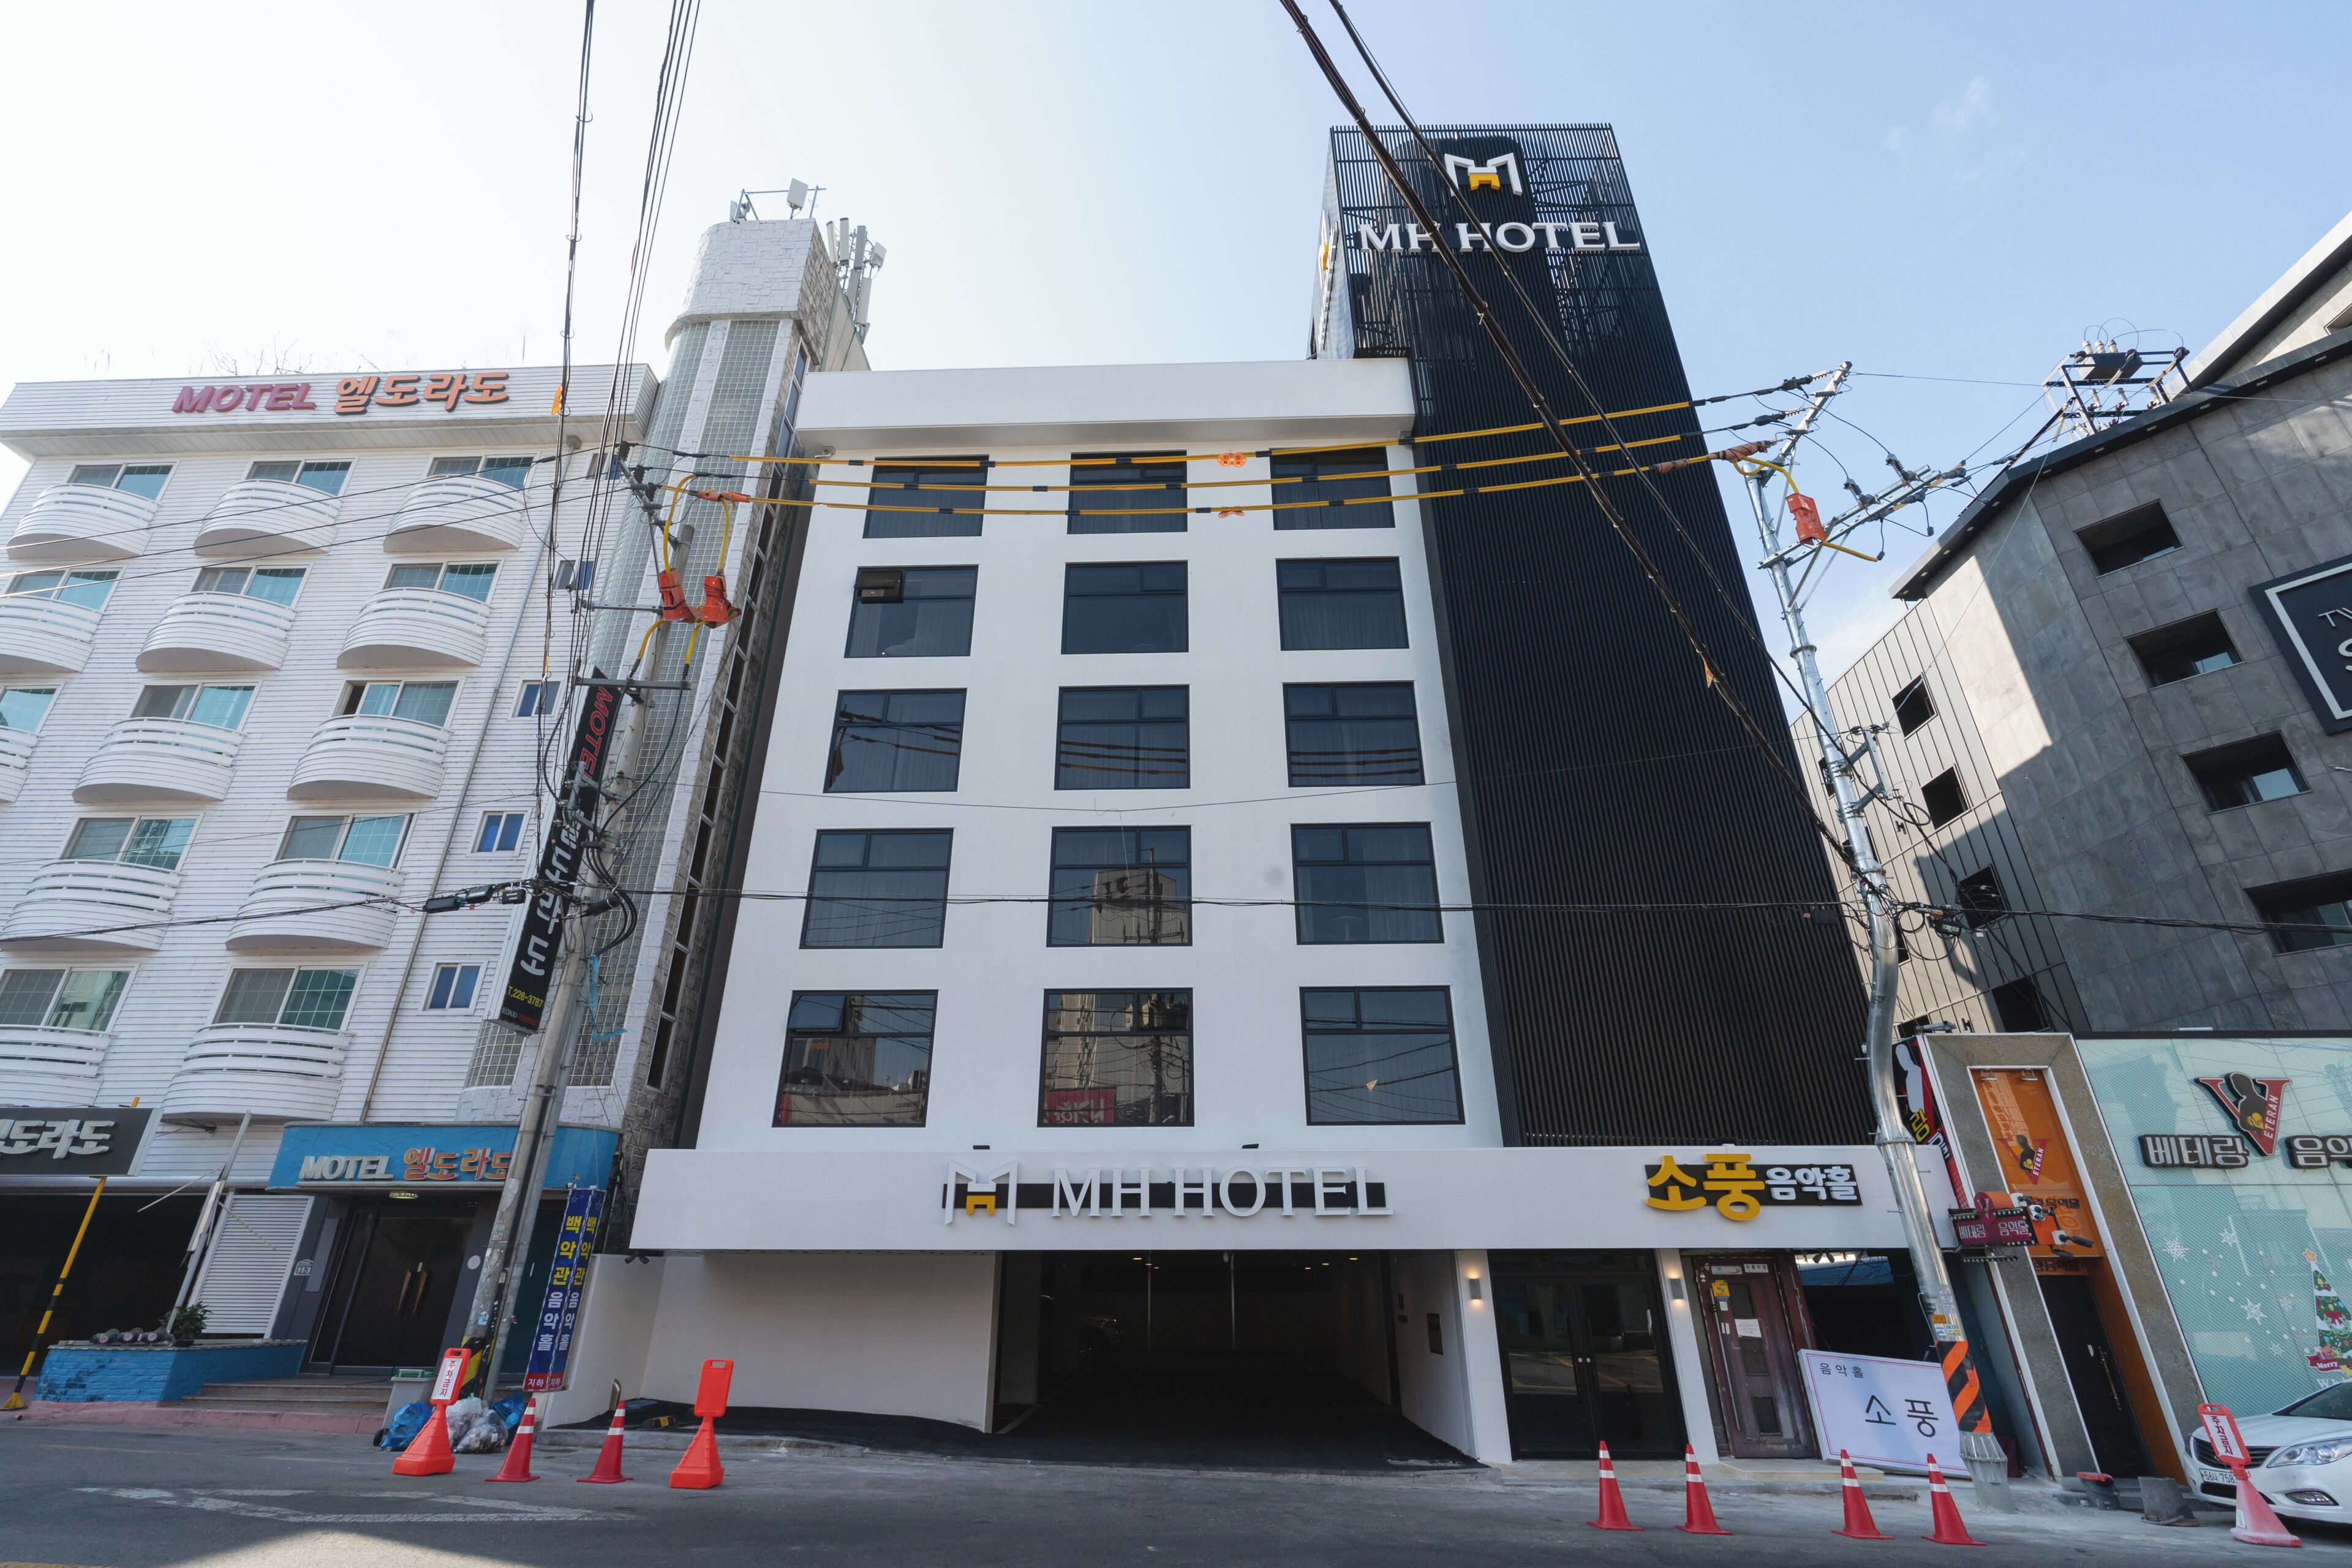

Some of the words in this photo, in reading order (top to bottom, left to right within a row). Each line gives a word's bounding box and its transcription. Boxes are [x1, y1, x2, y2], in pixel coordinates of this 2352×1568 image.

[1358, 222, 1442, 253] MH
[1455, 221, 1640, 252] HOTEL
[172, 382, 317, 413] MOTEL
[334, 372, 510, 415] 엘도라도
[579, 685, 613, 779] MOTE
[508, 986, 543, 1008] T.226-3787
[298, 1155, 394, 1180] MOTEL
[404, 1147, 514, 1181] 엘도라도
[1051, 1167, 1152, 1218] MH
[1173, 1166, 1393, 1218] HOTEL
[1645, 1153, 1765, 1221] 소풍
[1765, 1166, 1858, 1200] 음악홀
[552, 1215, 582, 1286] 백악관
[573, 1216, 597, 1286] 백악관
[537, 1291, 564, 1352] 음악홀
[558, 1292, 580, 1352] 음악홀
[440, 1360, 456, 1397] 주차금지
[527, 1379, 544, 1388] 지하
[549, 1378, 561, 1388] 지하
[1820, 1362, 1864, 1379] 음악홀
[1865, 1394, 1939, 1438] 소풍
[2211, 1415, 2234, 1456] 주차금지
